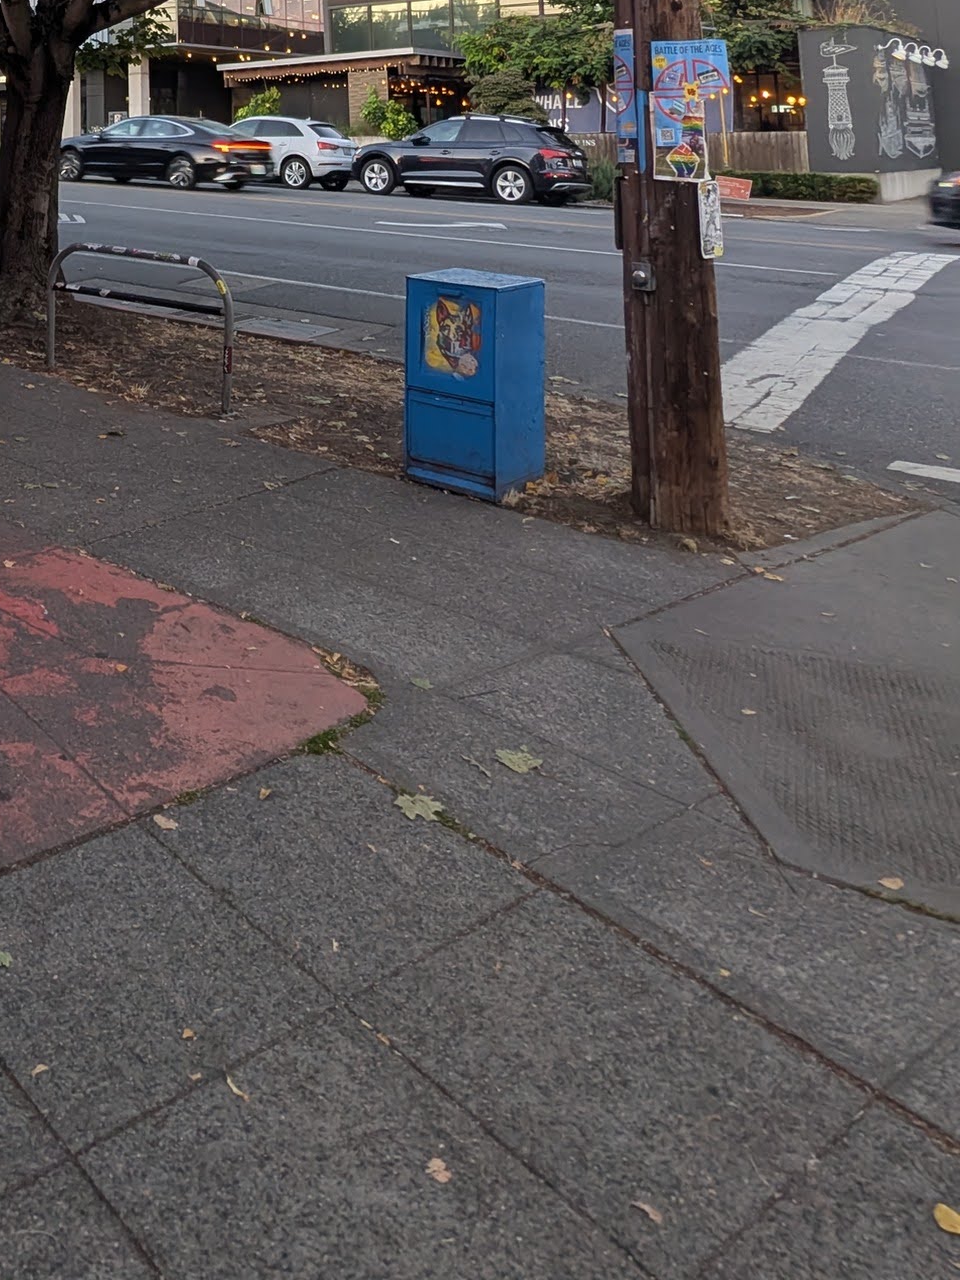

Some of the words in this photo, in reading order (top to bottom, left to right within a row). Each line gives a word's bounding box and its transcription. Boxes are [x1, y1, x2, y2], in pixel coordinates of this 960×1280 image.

[654, 46, 678, 54] BATTLE
[680, 45, 688, 54] OF
[690, 45, 703, 54] THE
[705, 44, 722, 53] AGES
